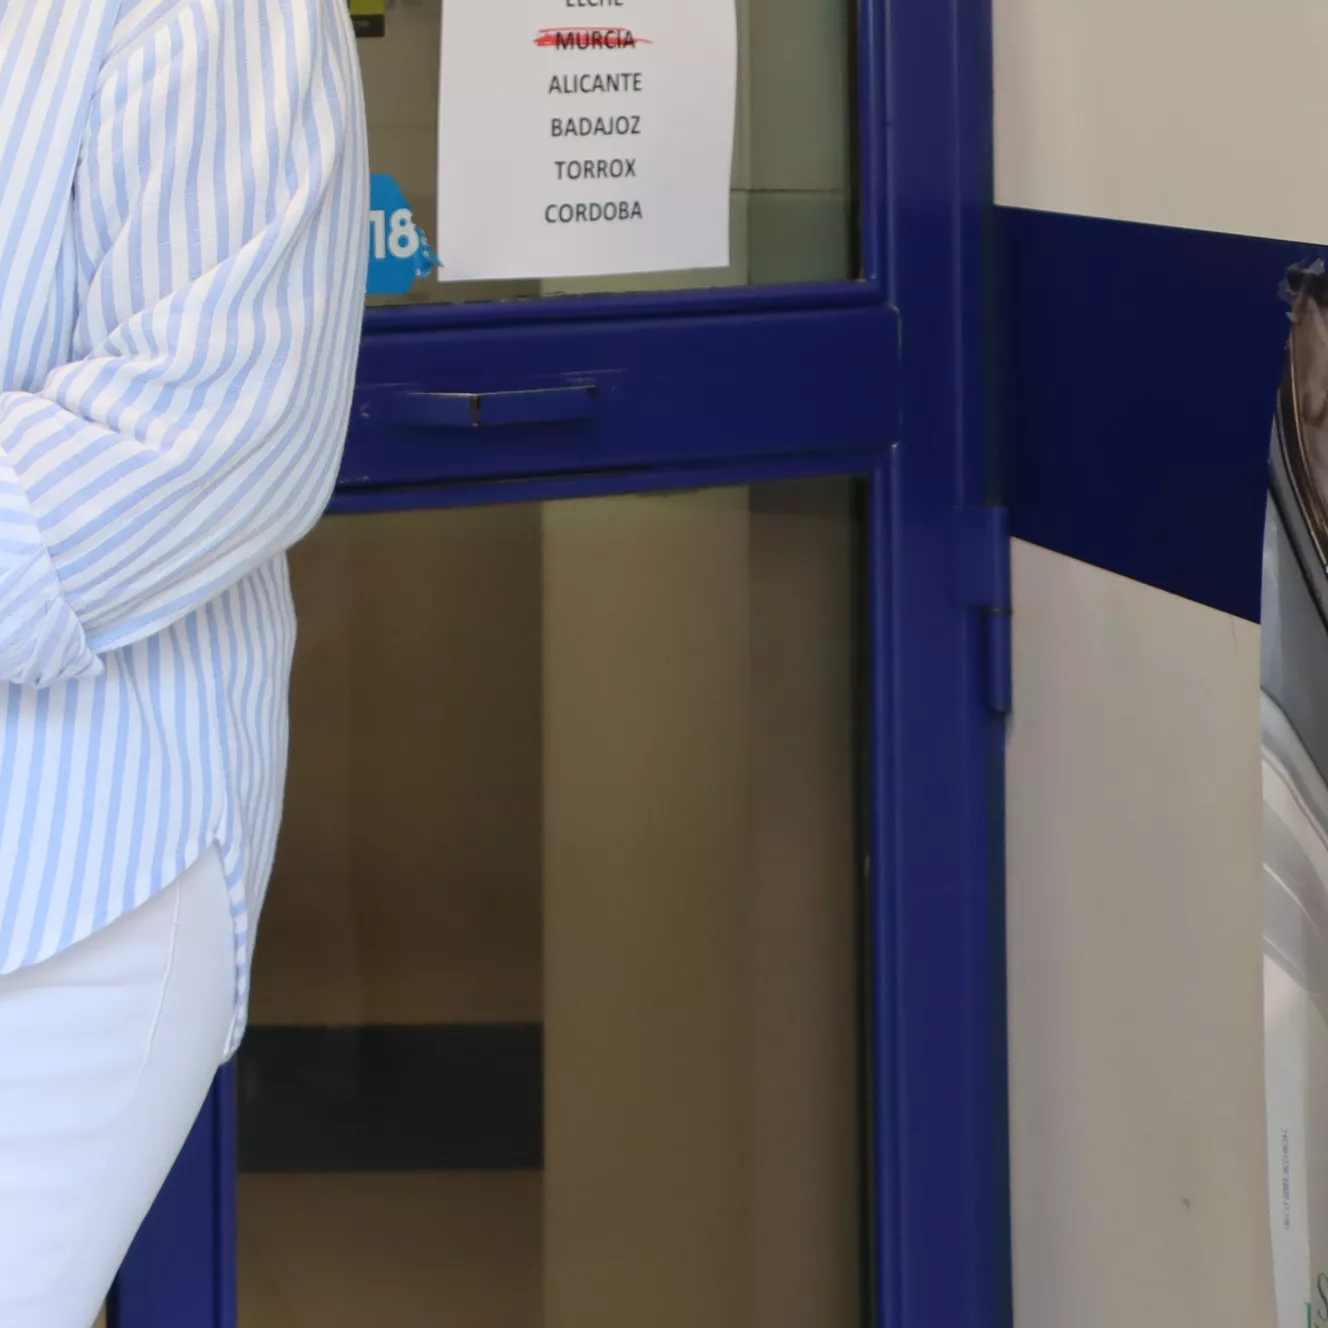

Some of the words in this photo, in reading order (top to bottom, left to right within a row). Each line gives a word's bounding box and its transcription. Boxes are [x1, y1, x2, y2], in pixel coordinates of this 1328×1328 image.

[555, 30, 635, 50] MURCIA
[548, 73, 643, 94] ALICANTE
[551, 116, 642, 137] BADAJOZ
[555, 159, 637, 180] TORROX
[544, 200, 643, 223] CORDOBA
